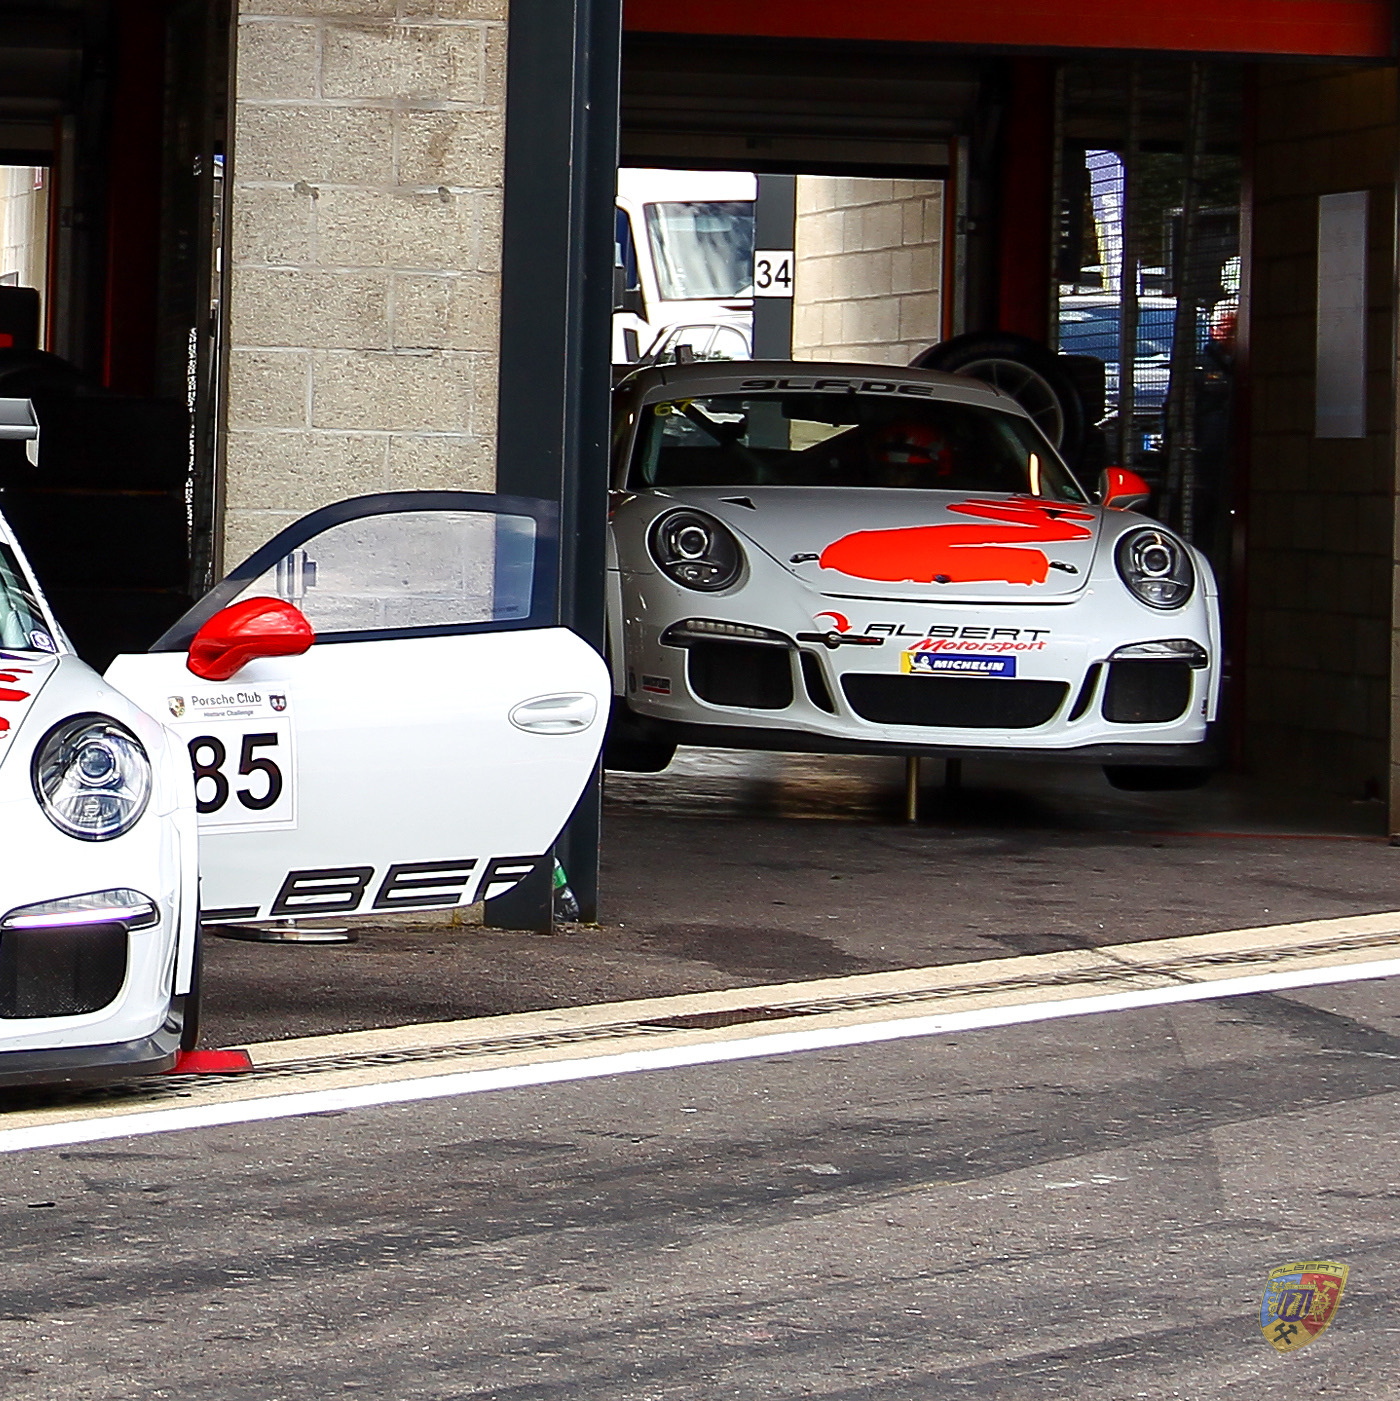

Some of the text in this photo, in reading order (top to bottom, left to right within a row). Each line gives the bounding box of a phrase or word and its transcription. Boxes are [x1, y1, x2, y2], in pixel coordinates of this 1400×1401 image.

[756, 258, 792, 289] 34
[864, 623, 1051, 641] ALBERT
[908, 637, 1047, 653] Motorsport
[932, 659, 1005, 672] MICHELIN
[191, 691, 262, 706] Porsche Club
[188, 732, 283, 814] 85
